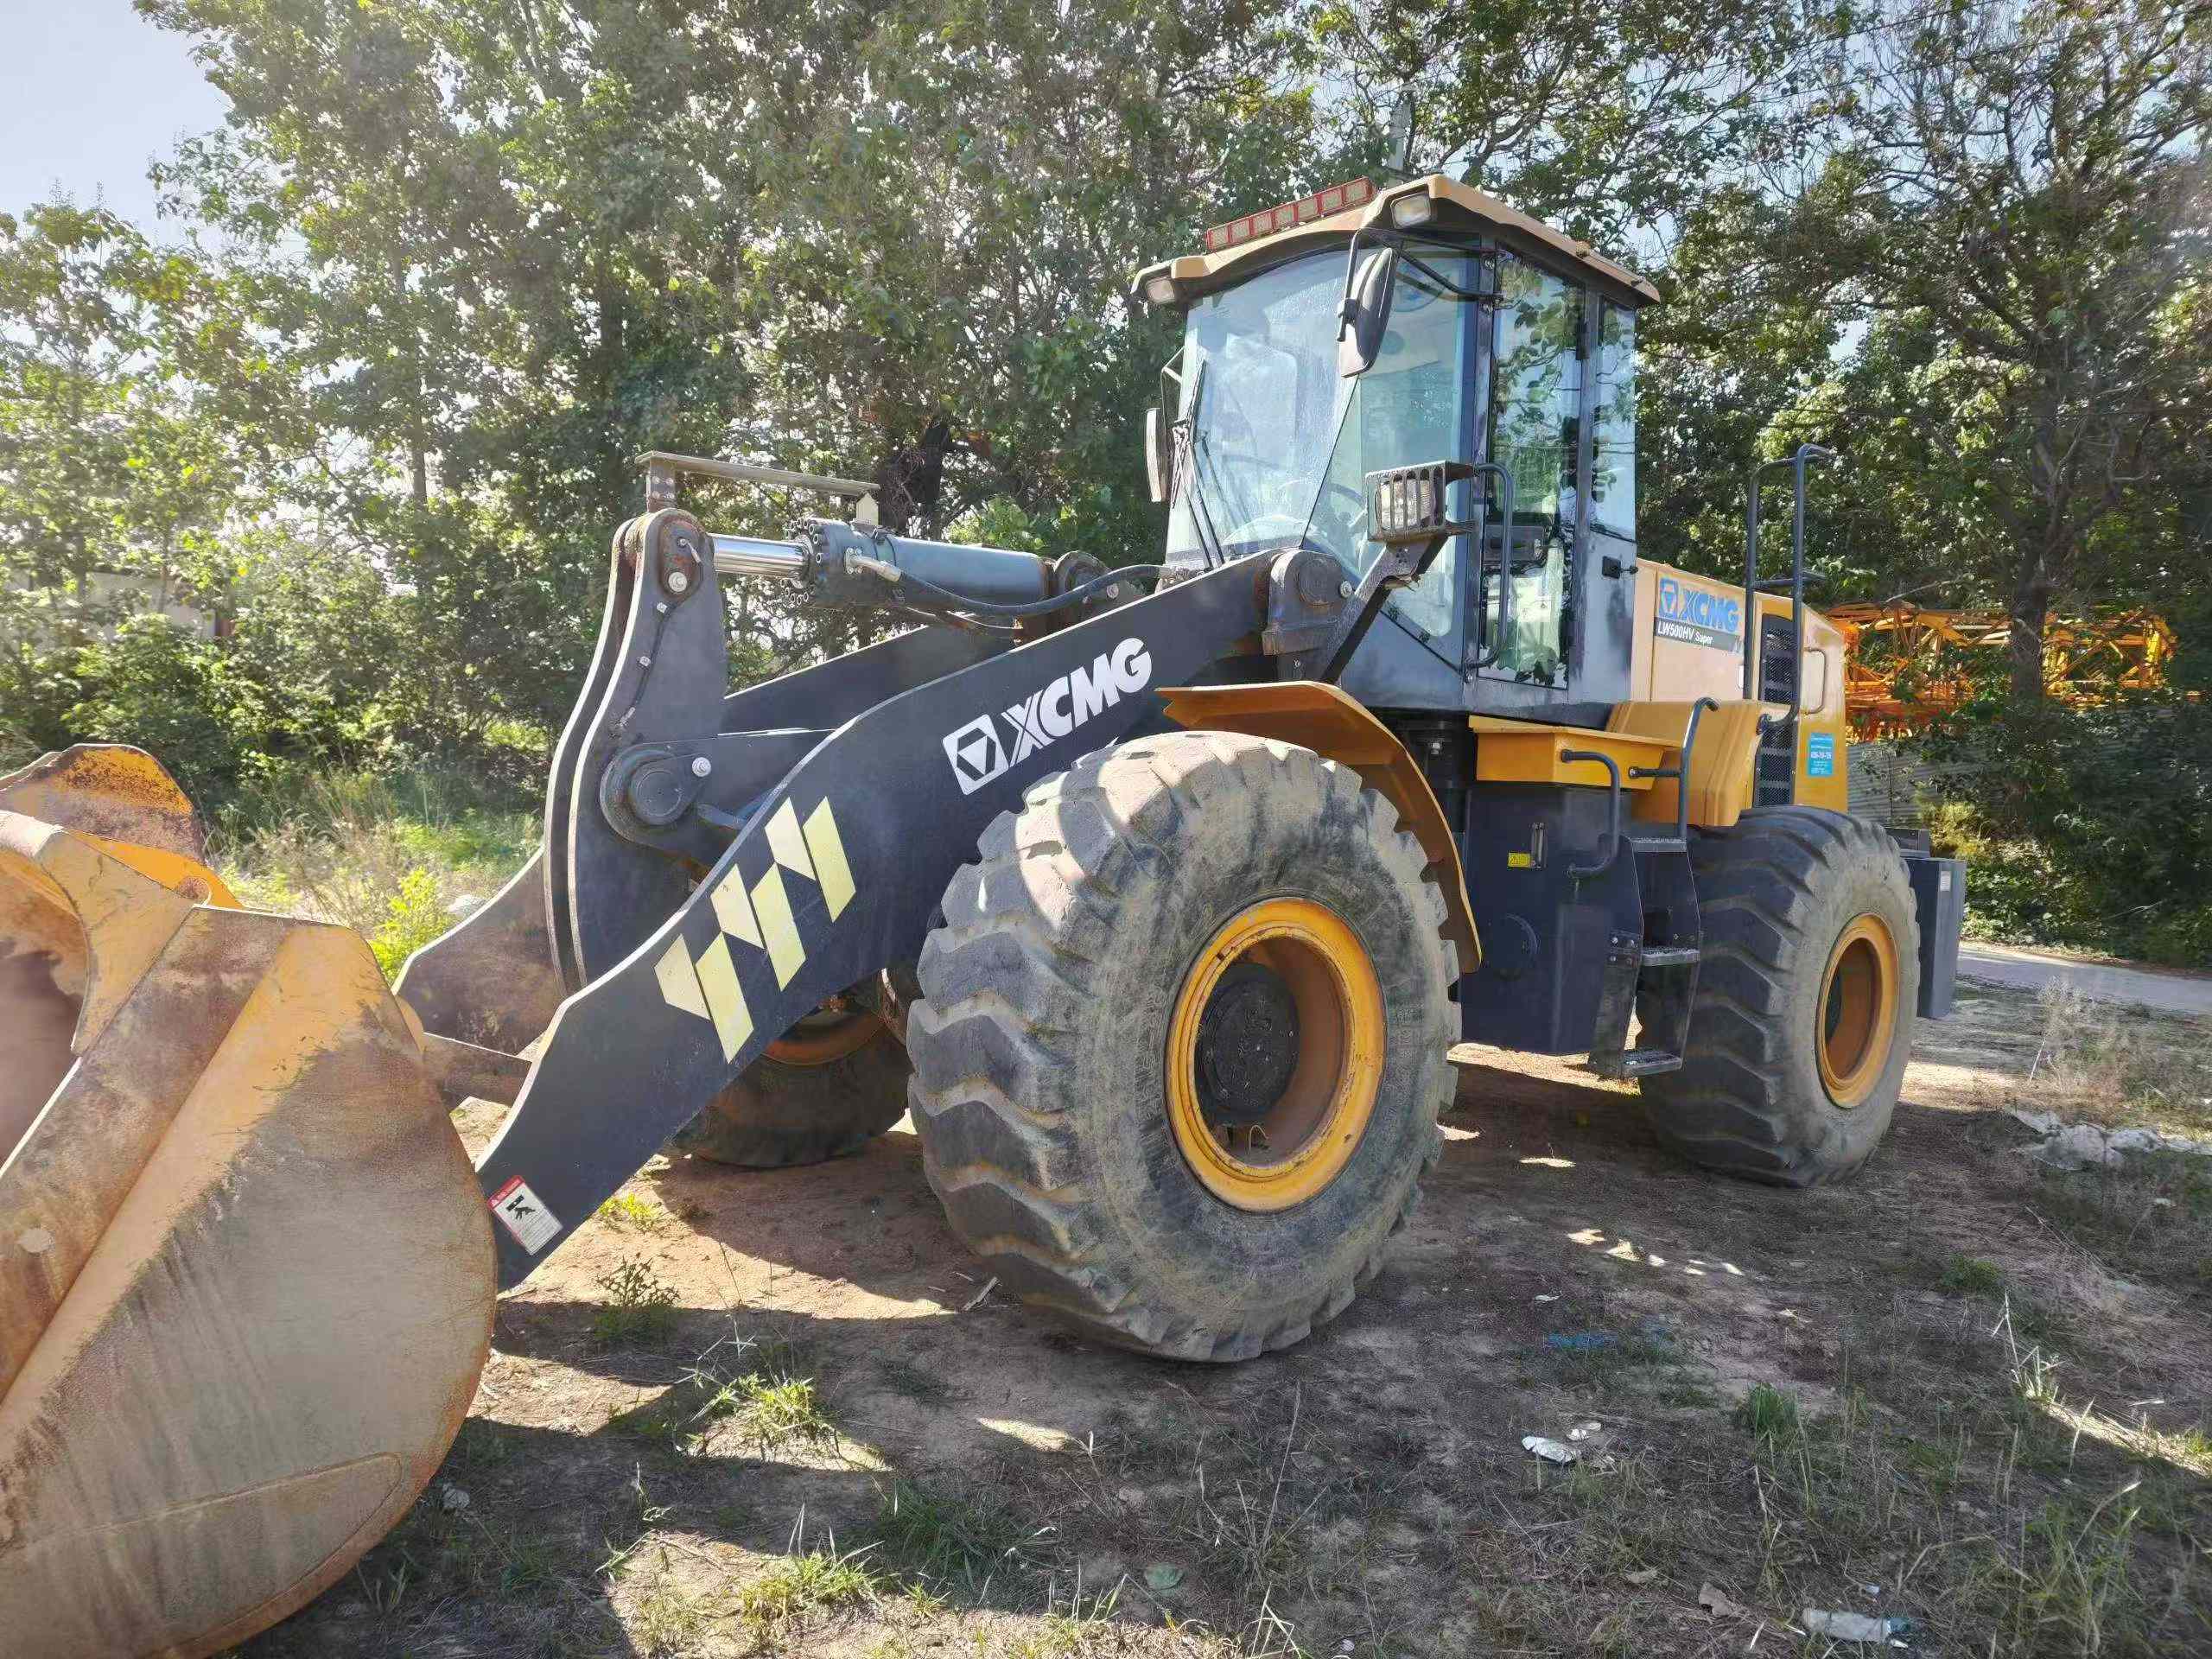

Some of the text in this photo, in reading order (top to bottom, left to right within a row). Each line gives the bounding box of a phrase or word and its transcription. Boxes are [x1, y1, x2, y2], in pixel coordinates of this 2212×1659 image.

[1657, 621, 1694, 640] LW500HV
[1679, 588, 1739, 632] XCMG
[1001, 638, 1152, 767] XCMG
